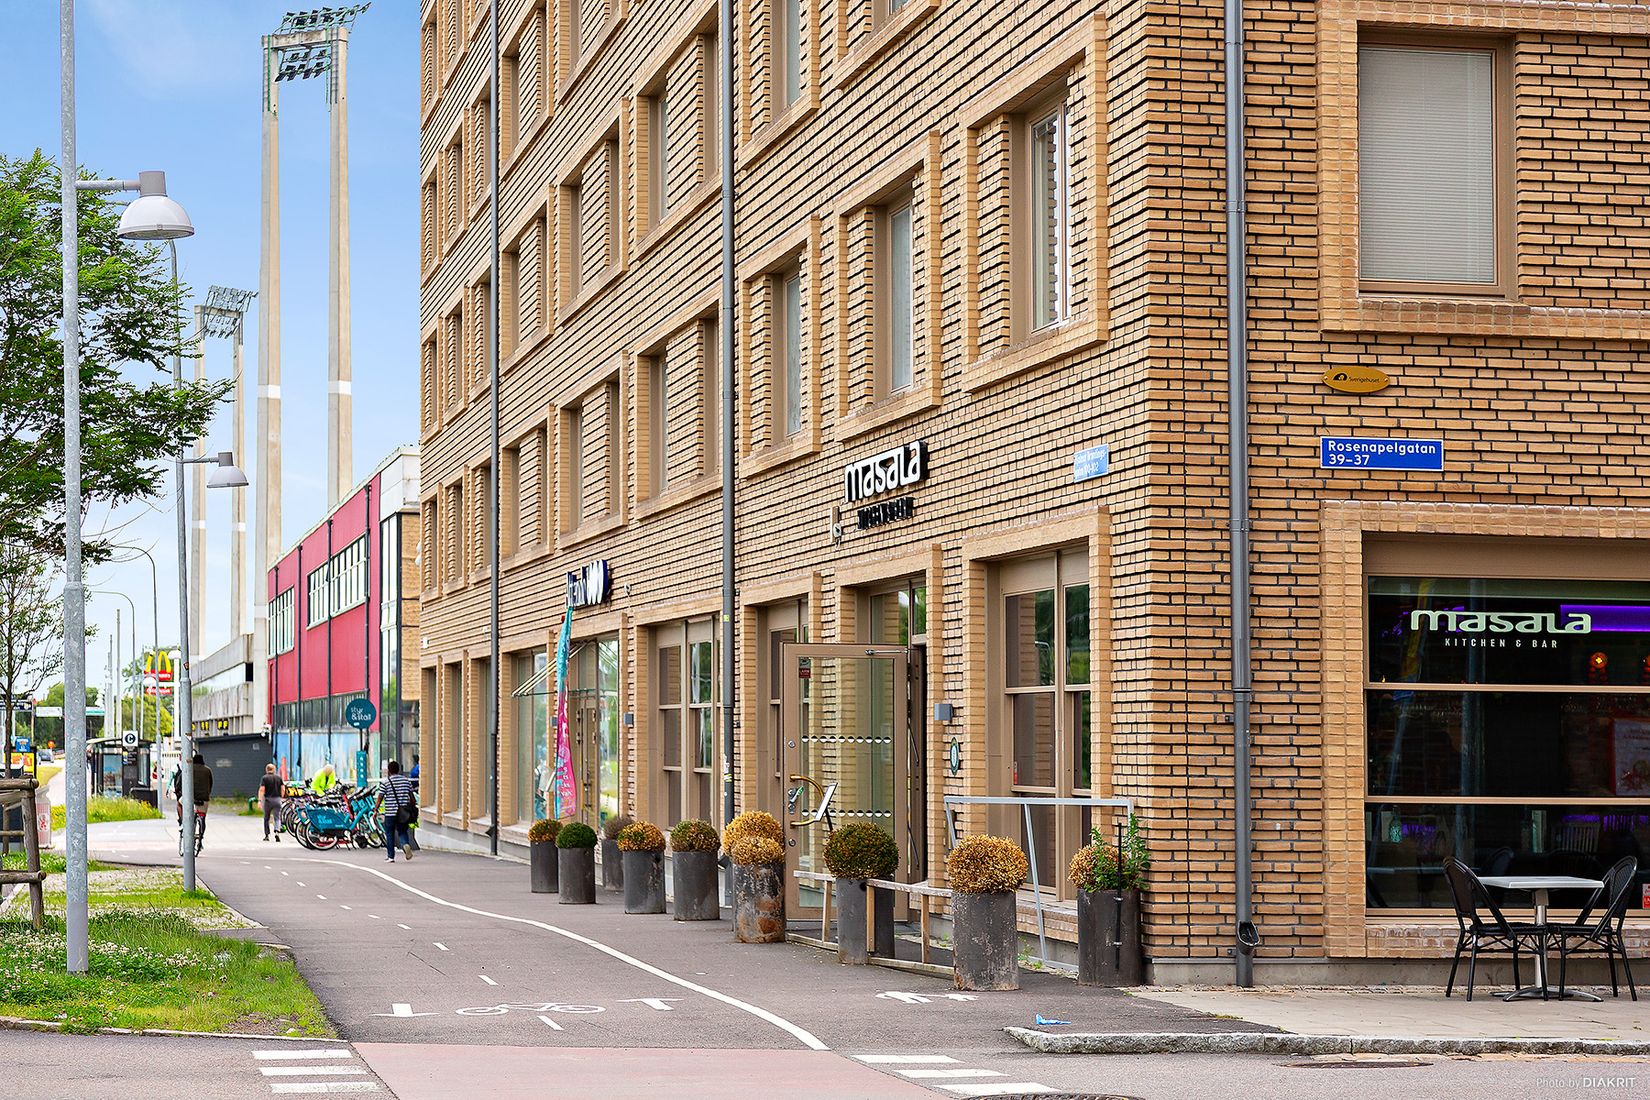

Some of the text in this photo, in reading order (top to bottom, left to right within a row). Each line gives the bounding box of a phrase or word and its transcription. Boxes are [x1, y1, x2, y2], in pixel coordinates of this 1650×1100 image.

[1328, 440, 1436, 456] Rosenapelgatan
[1329, 453, 1370, 466] 39-37
[1410, 609, 1592, 634] masala
[1445, 638, 1558, 649] KITCHEN & BAR
